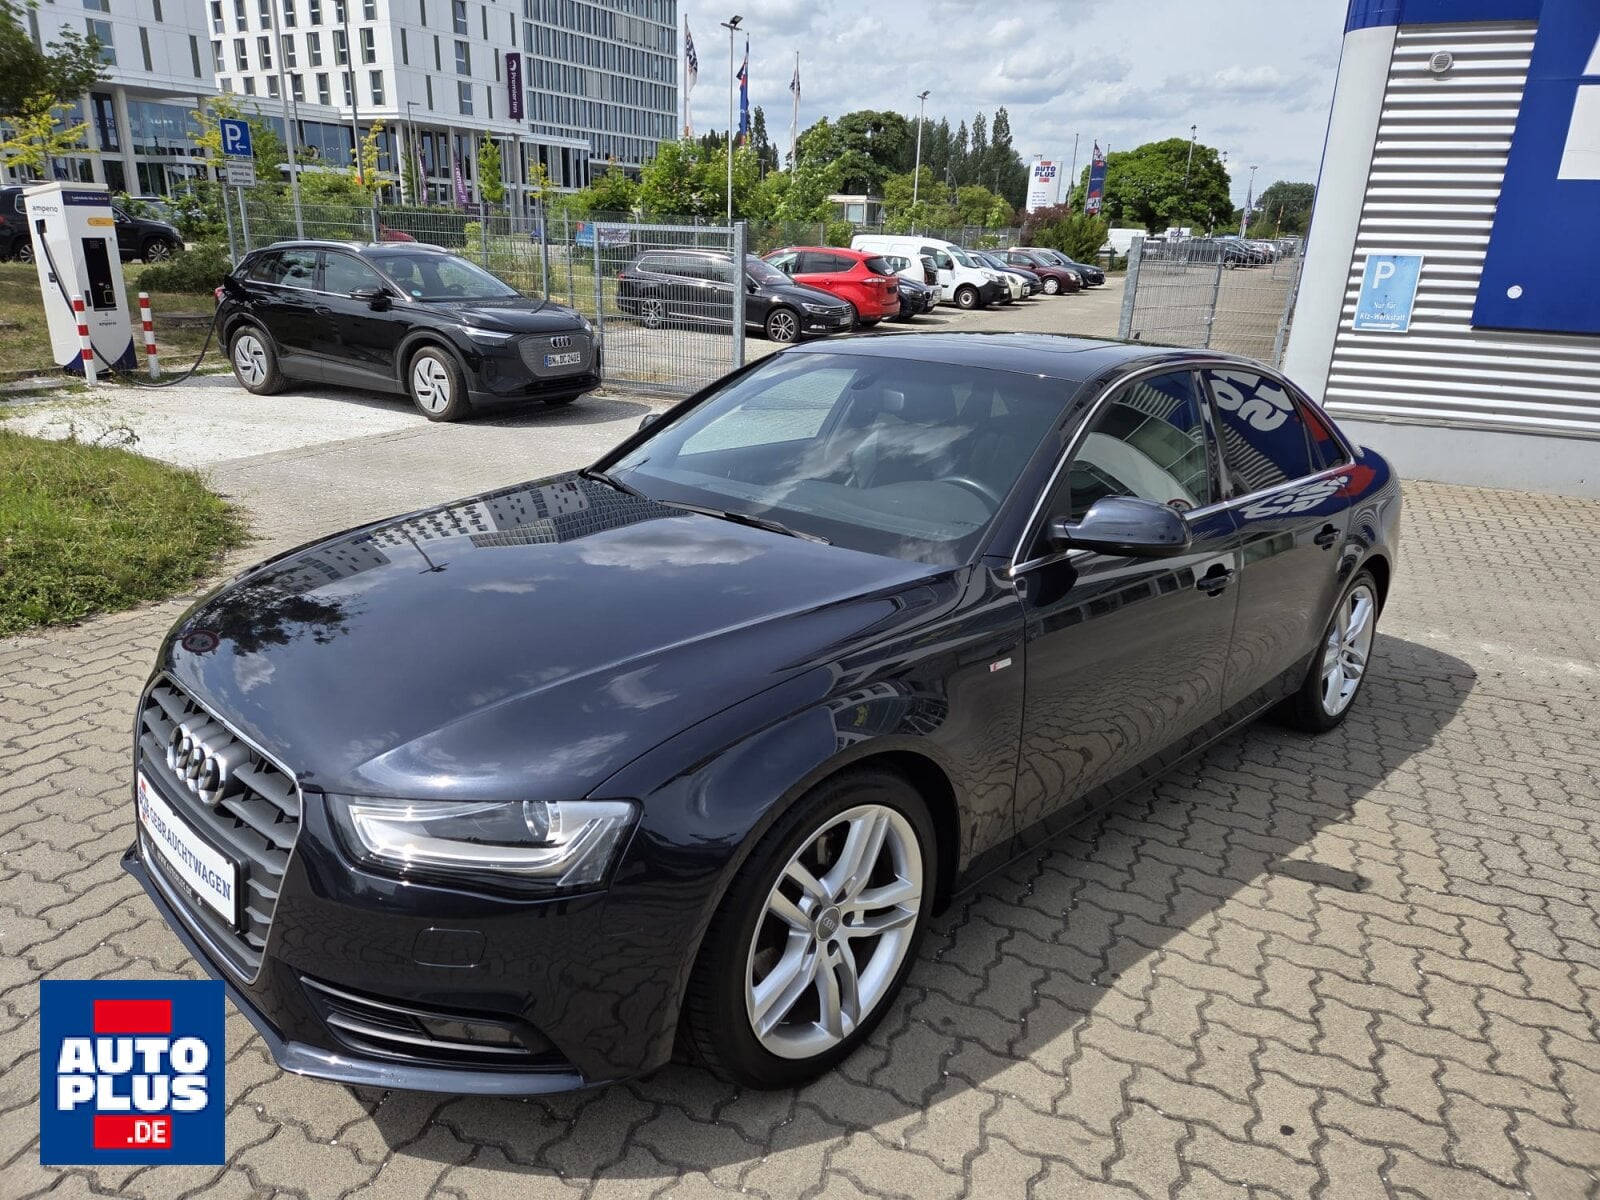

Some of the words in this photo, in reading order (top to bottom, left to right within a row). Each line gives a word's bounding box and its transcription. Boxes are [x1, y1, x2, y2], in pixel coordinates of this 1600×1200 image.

[225, 123, 242, 151] P
[32, 205, 59, 214] amperio
[1372, 261, 1396, 289] P
[1374, 301, 1385, 309] Nur
[1386, 301, 1397, 309] für
[1359, 312, 1406, 321] Kfz-Werkstatt
[150, 807, 232, 901] GEBRAUCHTWAGEN
